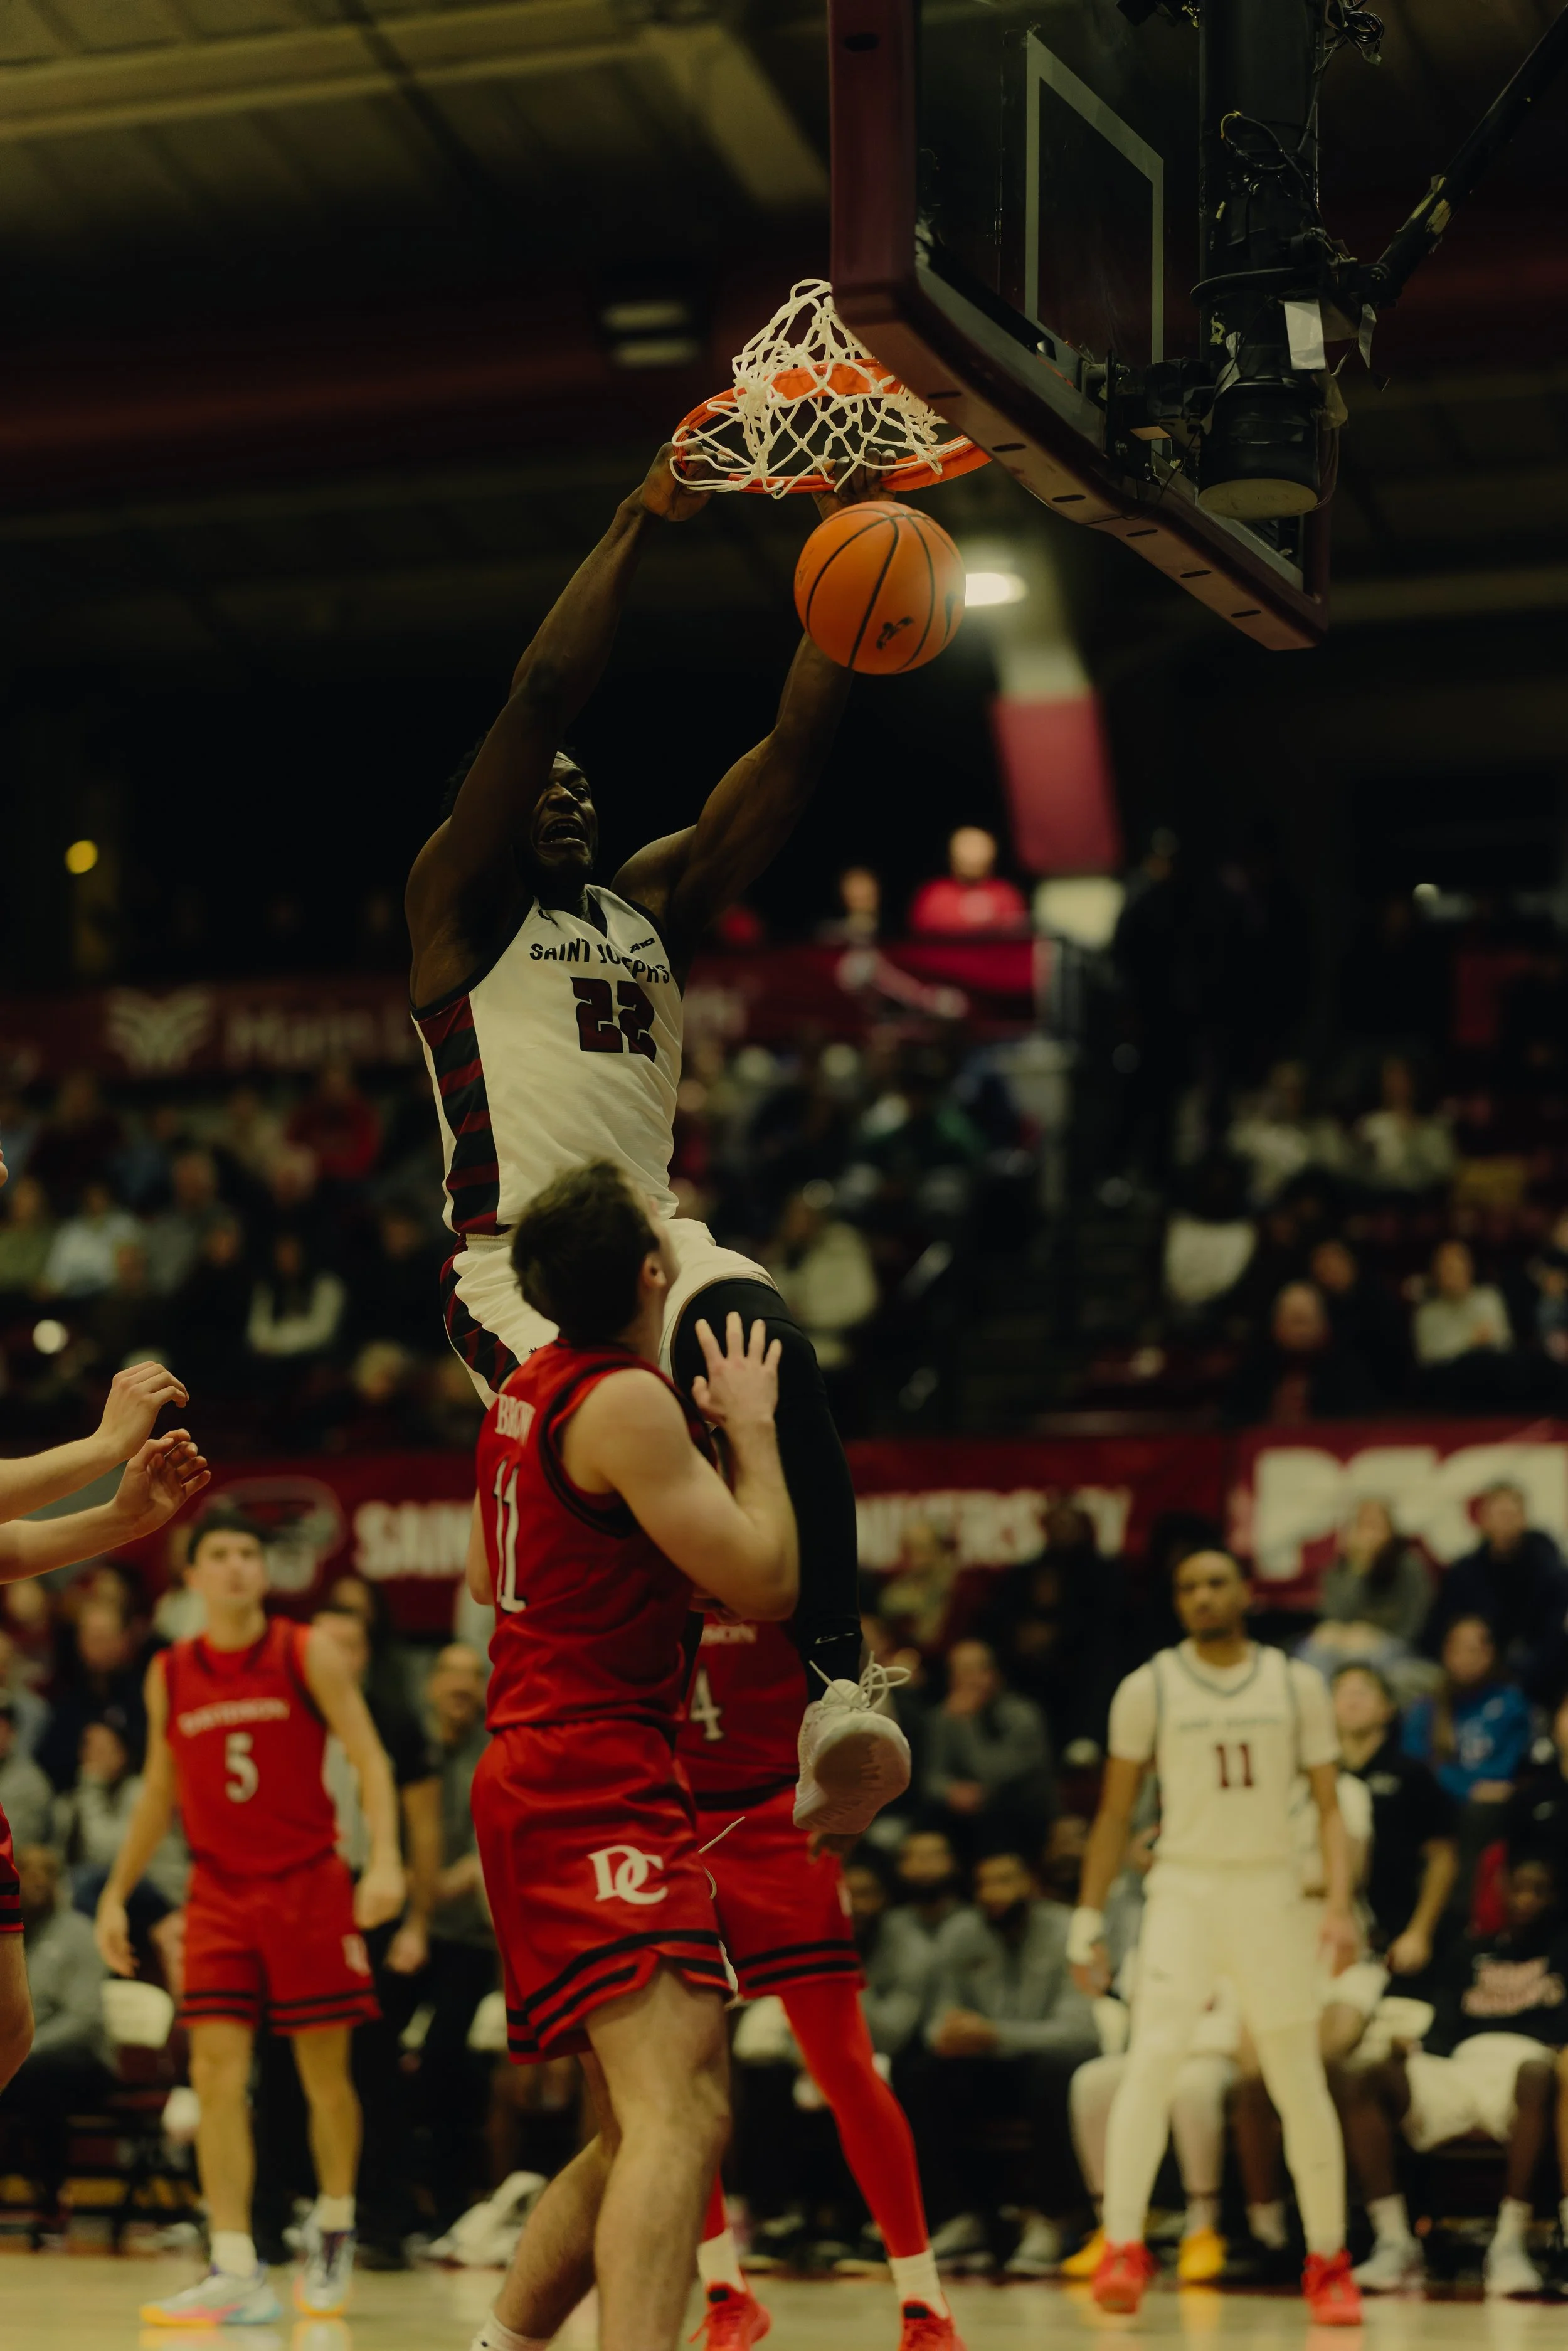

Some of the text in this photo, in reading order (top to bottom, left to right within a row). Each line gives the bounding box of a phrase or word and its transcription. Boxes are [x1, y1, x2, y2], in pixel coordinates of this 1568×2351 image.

[529, 938, 591, 962] SAINT
[569, 975, 657, 1063] 22
[492, 1458, 528, 1614] 11
[689, 1664, 725, 1741] 4
[224, 1731, 261, 1804] 5
[1215, 1742, 1255, 1788] 11
[586, 1844, 669, 1905] DC
